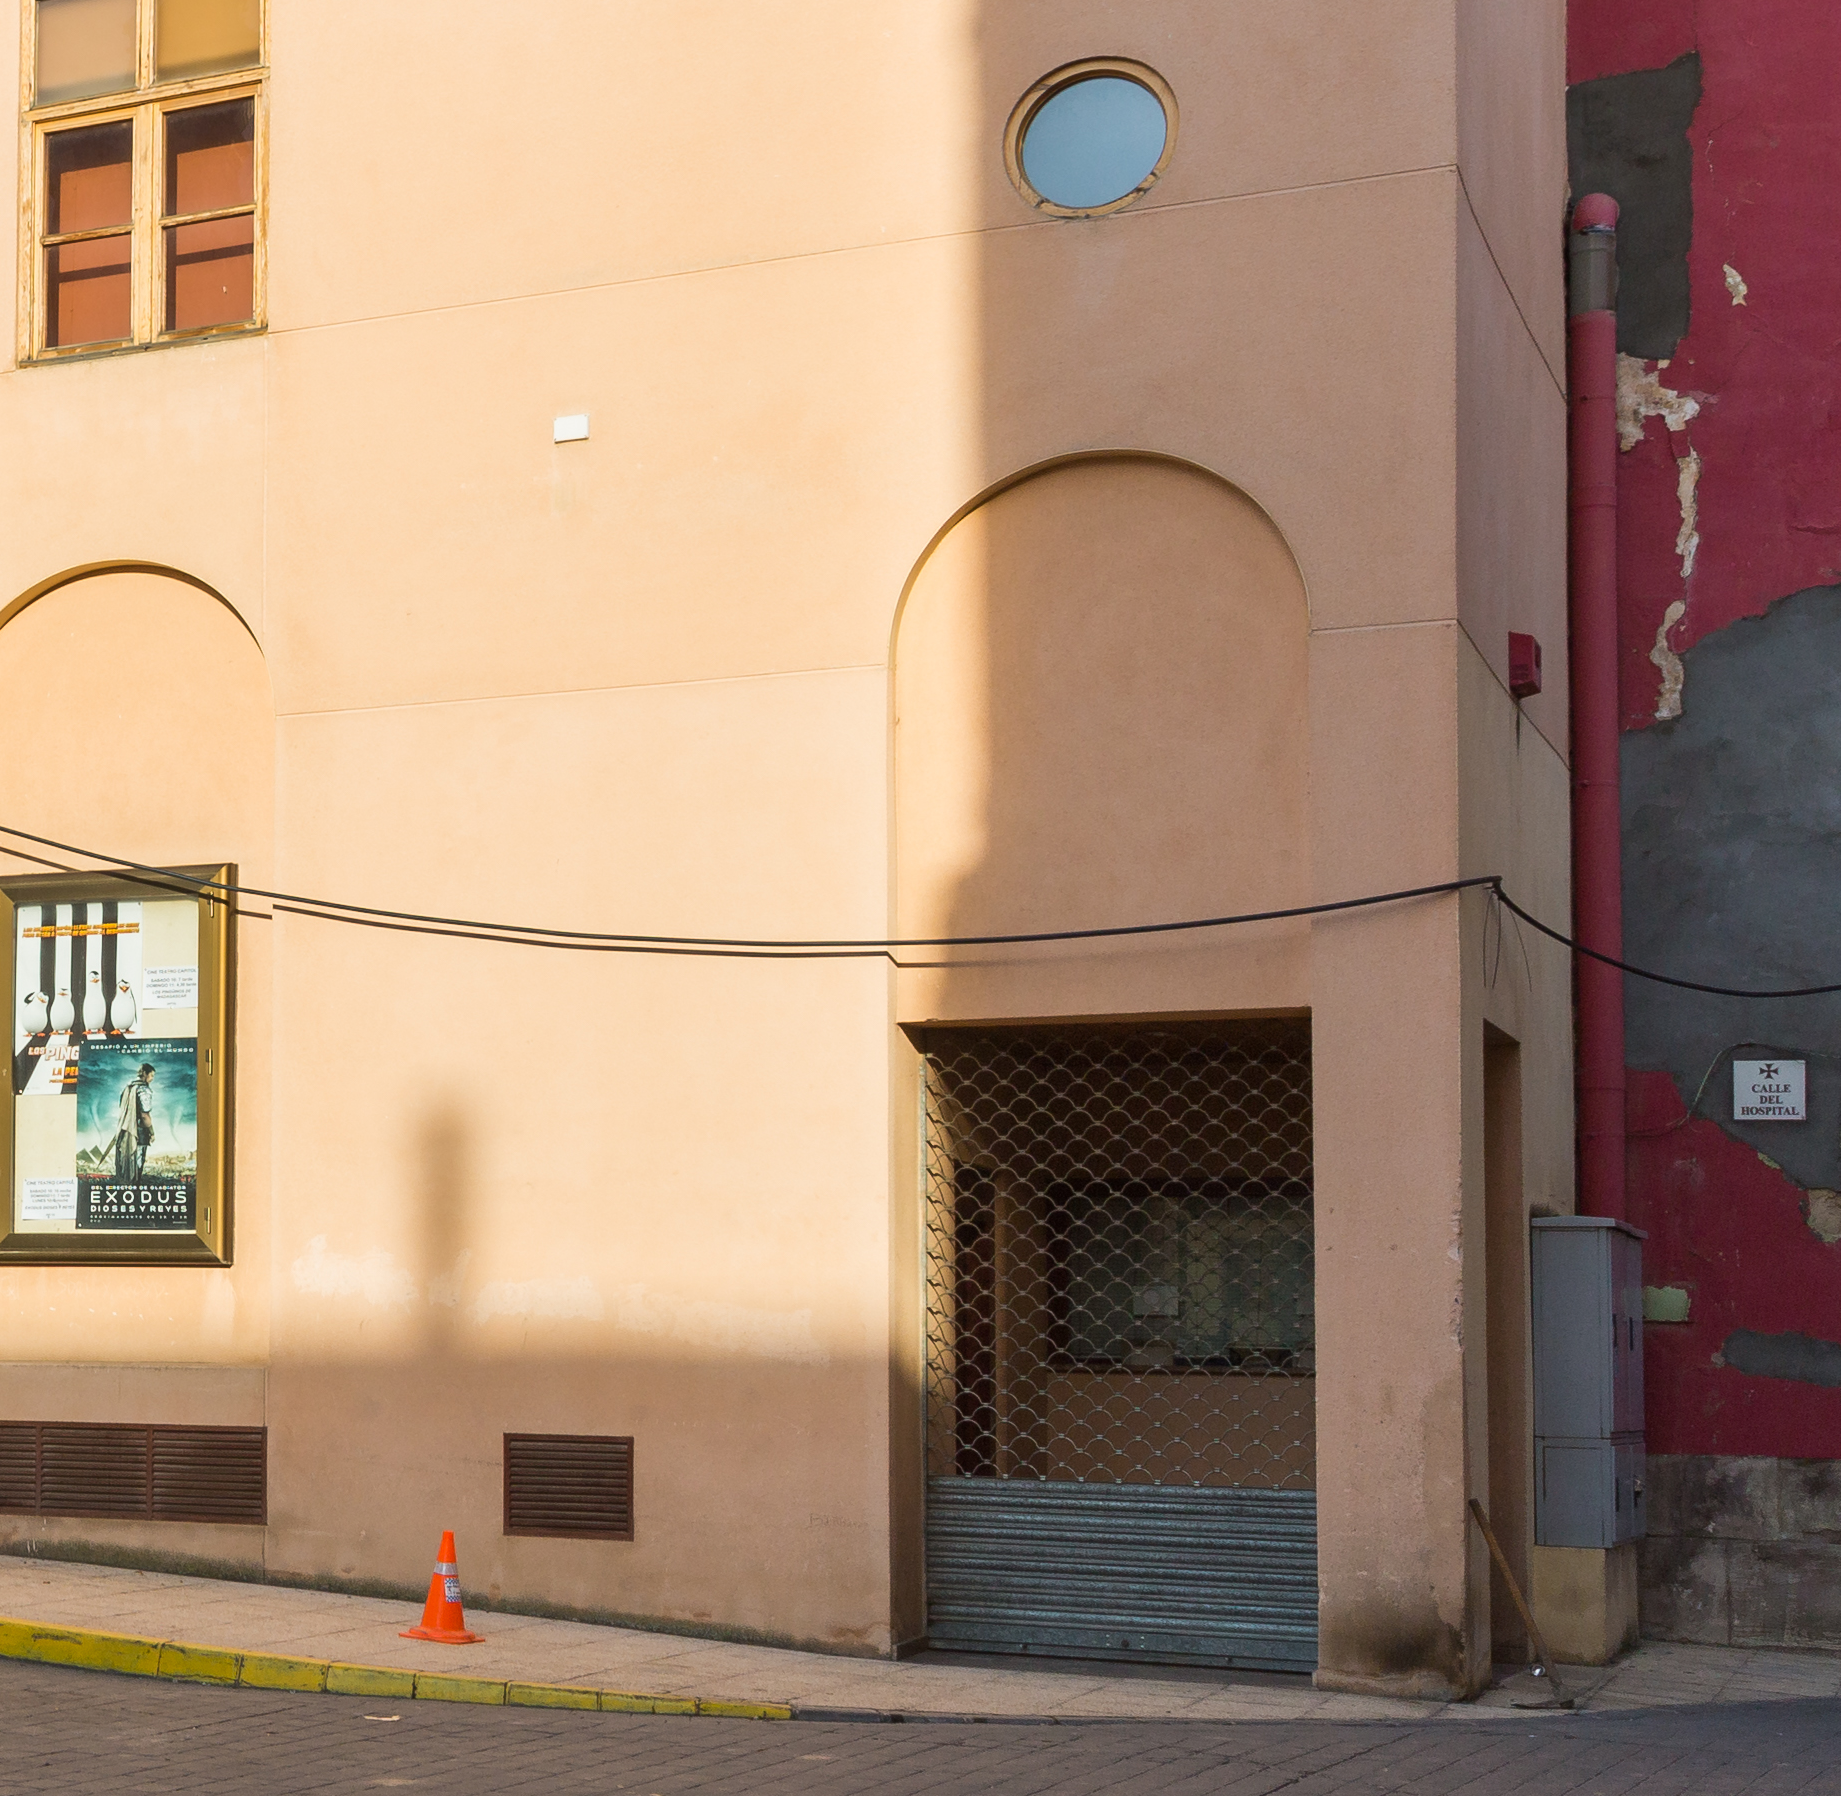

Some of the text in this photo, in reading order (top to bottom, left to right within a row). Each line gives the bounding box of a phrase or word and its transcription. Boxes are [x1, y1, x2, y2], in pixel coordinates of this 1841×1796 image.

[28, 1046, 46, 1056] LOS
[52, 1067, 62, 1076] LA
[1751, 1084, 1791, 1093] CALLE
[1759, 1095, 1783, 1104] DEL
[1741, 1107, 1799, 1116] HOSPITAL
[90, 1191, 187, 1203] EXODUS
